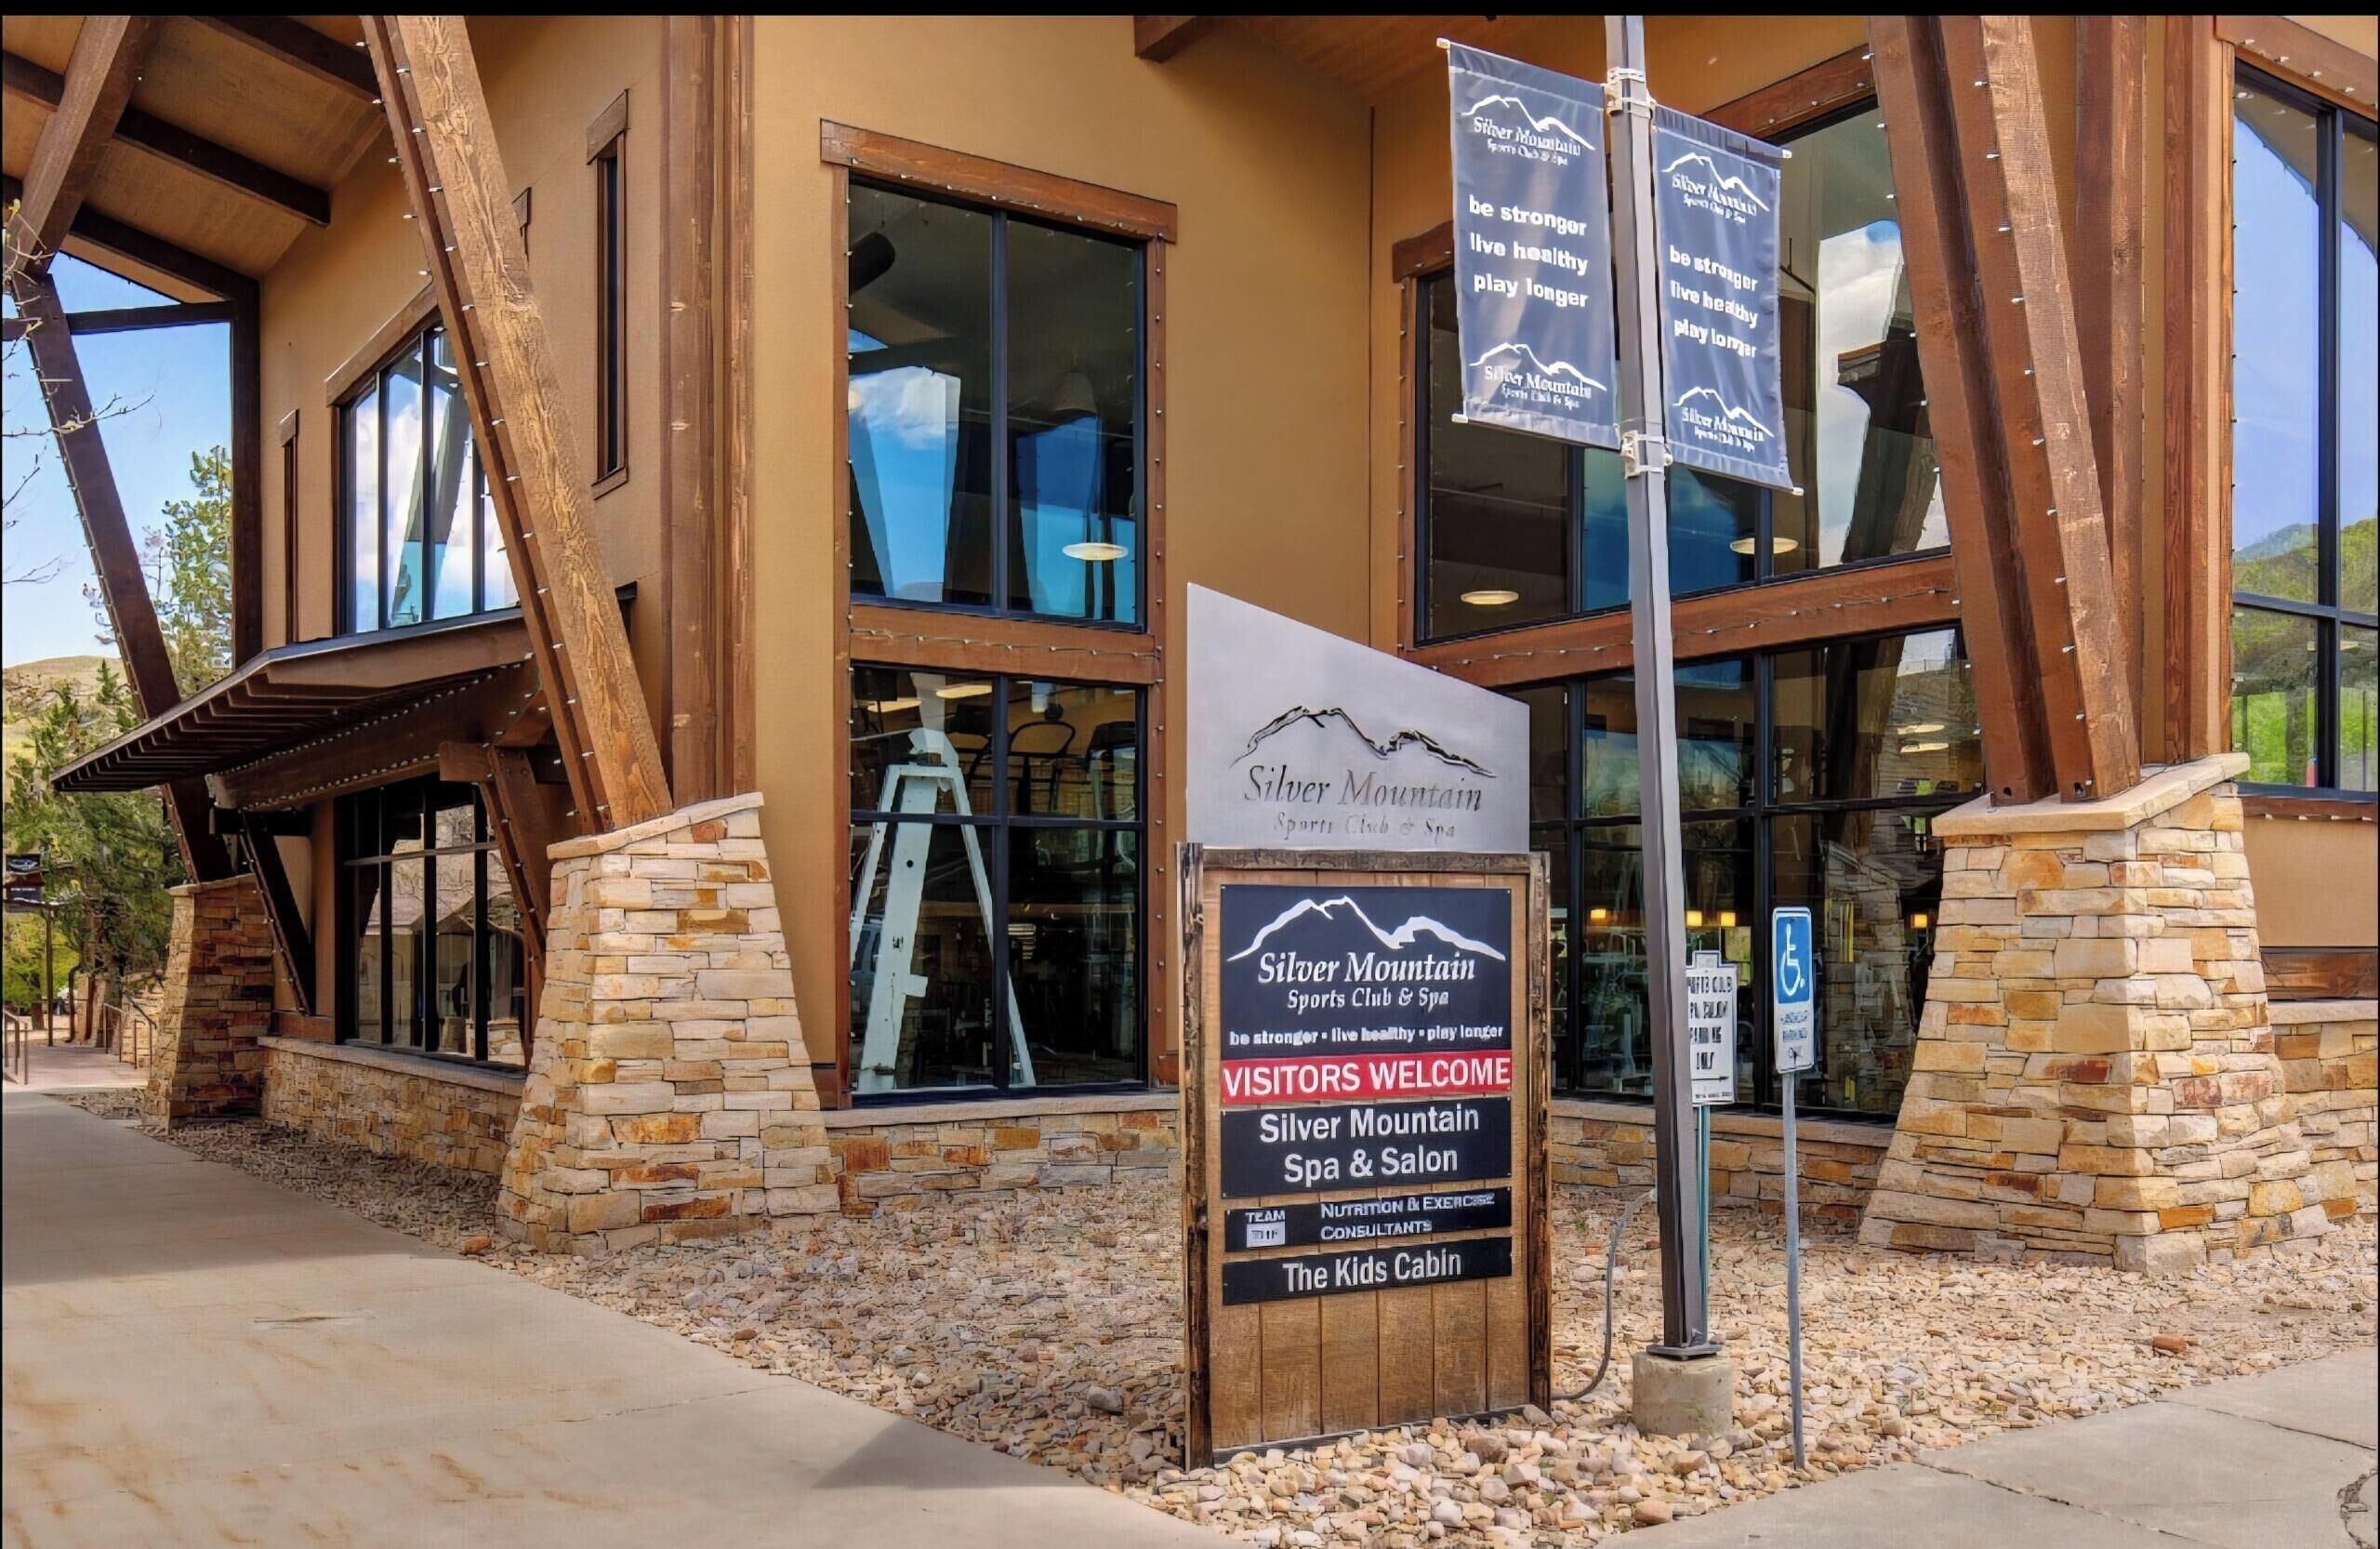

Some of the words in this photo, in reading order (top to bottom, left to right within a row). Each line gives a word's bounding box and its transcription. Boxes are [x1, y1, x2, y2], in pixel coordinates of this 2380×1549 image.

[1469, 193, 1494, 217] be
[1501, 205, 1587, 236] stronger
[1470, 232, 1506, 257] live
[1513, 240, 1589, 276] healthy
[1670, 245, 1691, 266] be
[1693, 257, 1758, 292] stronger
[1474, 272, 1519, 298] play
[1526, 277, 1589, 308] longer
[1671, 279, 1700, 304] live
[1702, 291, 1758, 329] healthy
[1673, 318, 1709, 345] play
[1711, 327, 1757, 358] longer
[1244, 764, 1330, 805] Silver
[1338, 769, 1483, 812] Mountain
[1274, 812, 1333, 841] Sports
[1423, 817, 1456, 844] Spa
[1258, 952, 1340, 984] Silver
[1344, 949, 1475, 983] Mountain
[1288, 988, 1346, 1015] Sports
[1352, 987, 1392, 1007] Club
[1398, 987, 1414, 1006] &
[1419, 986, 1449, 1013] Spa
[1229, 1030, 1250, 1046] be
[1253, 1030, 1318, 1047] stronger
[1331, 1027, 1358, 1043] live
[1361, 1026, 1415, 1044] healthy
[1427, 1026, 1458, 1041] play
[1460, 1024, 1503, 1041] longer
[1223, 1062, 1361, 1098] VISITORS
[1368, 1057, 1512, 1091] WELCOME
[1260, 1113, 1342, 1144] Silver
[1350, 1104, 1479, 1139] Mountain
[1284, 1154, 1340, 1188] Spa
[1349, 1149, 1374, 1178] &
[1381, 1145, 1458, 1177] Salon
[1245, 1210, 1286, 1224] TEAM
[1283, 1262, 1328, 1293] The
[1335, 1256, 1388, 1288] Kids
[1395, 1249, 1462, 1282] Cabin
